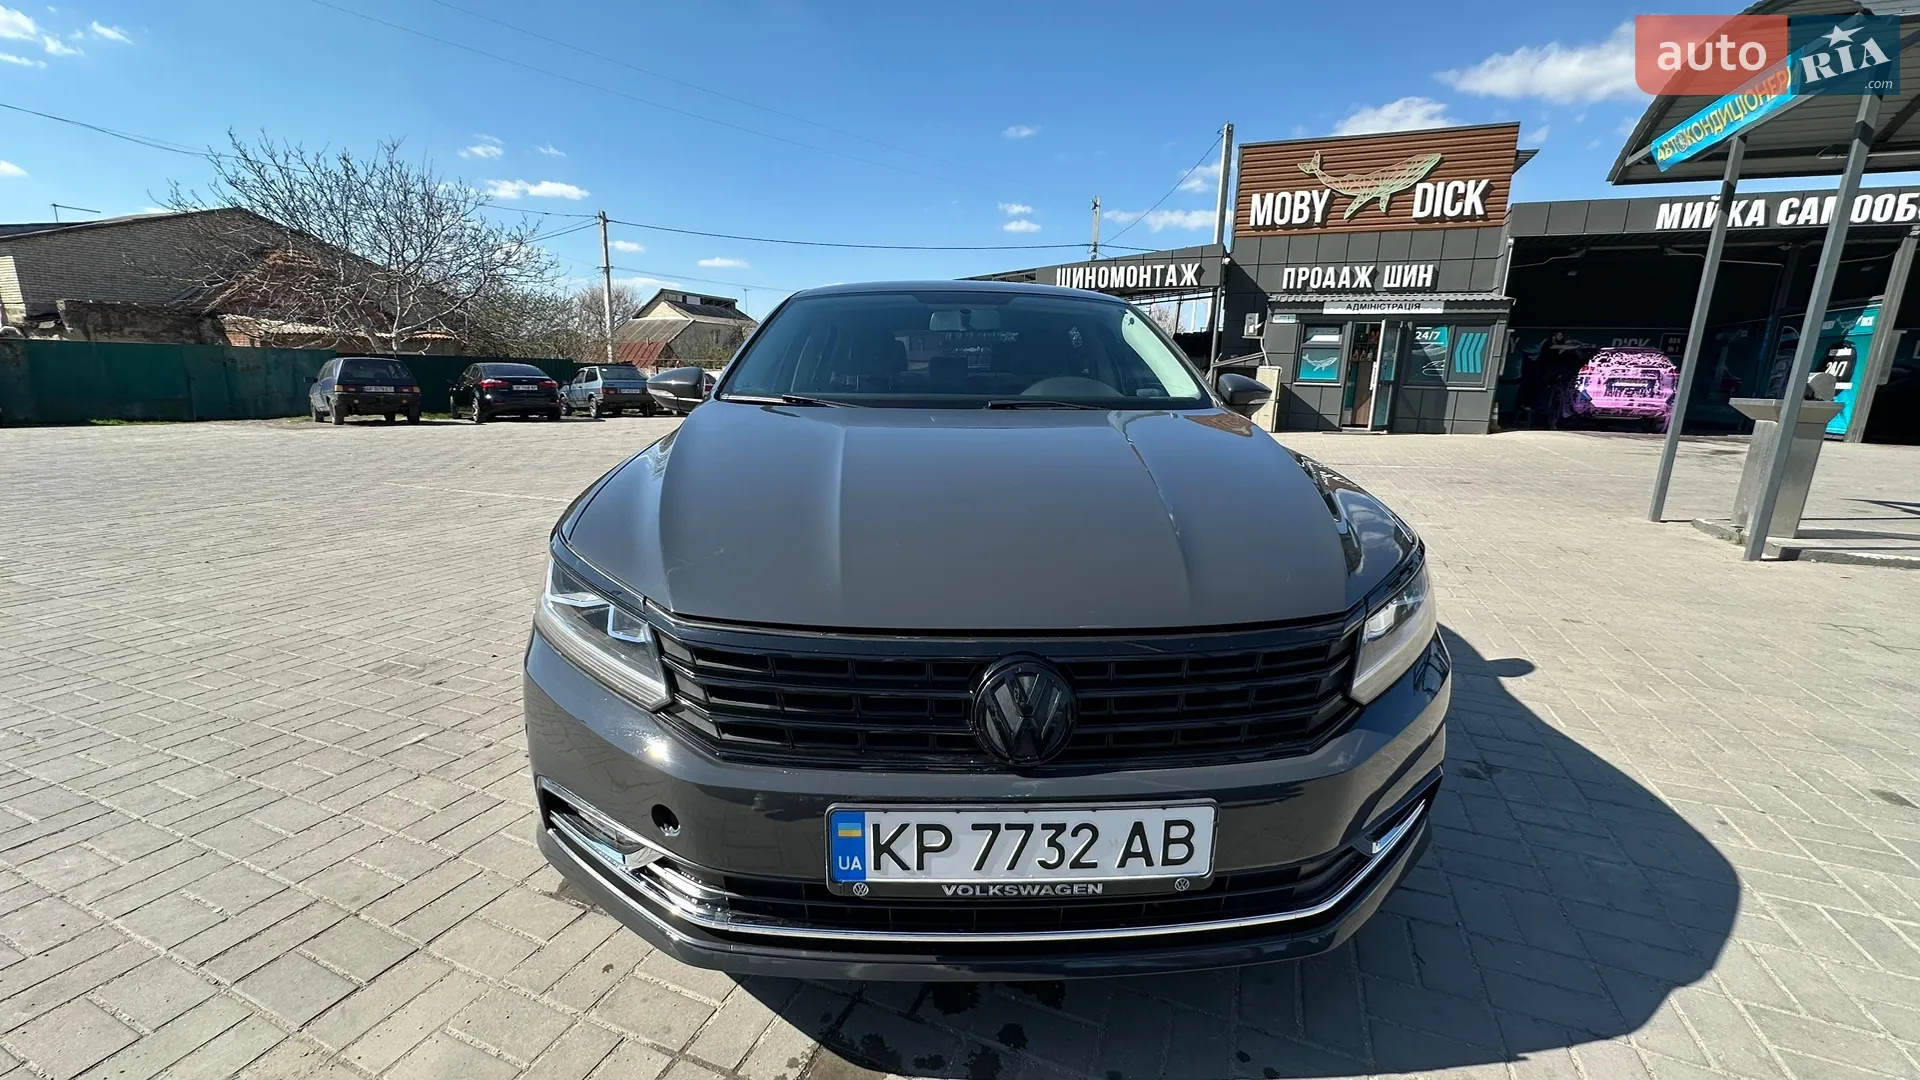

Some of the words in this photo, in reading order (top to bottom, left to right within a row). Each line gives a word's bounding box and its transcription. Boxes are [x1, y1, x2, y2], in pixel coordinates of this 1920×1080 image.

[1249, 188, 1331, 227] MOBY
[1412, 178, 1490, 218] DICK
[1655, 195, 1766, 230] МИЙКА
[1777, 192, 1920, 225] САООБ
[1055, 262, 1201, 288] ШИНОМОНТАЖ
[1282, 264, 1376, 289] ПРОДАЖ
[1383, 264, 1435, 288] ШИН
[1345, 301, 1421, 312] АДМІНІСТРАЦІЯ
[1414, 330, 1441, 341] 24/7
[838, 855, 862, 871] UA
[870, 822, 953, 871] KP
[971, 821, 1099, 871] 7732
[1116, 818, 1195, 869] AB
[942, 883, 1103, 897] VOLKSWAGEN
